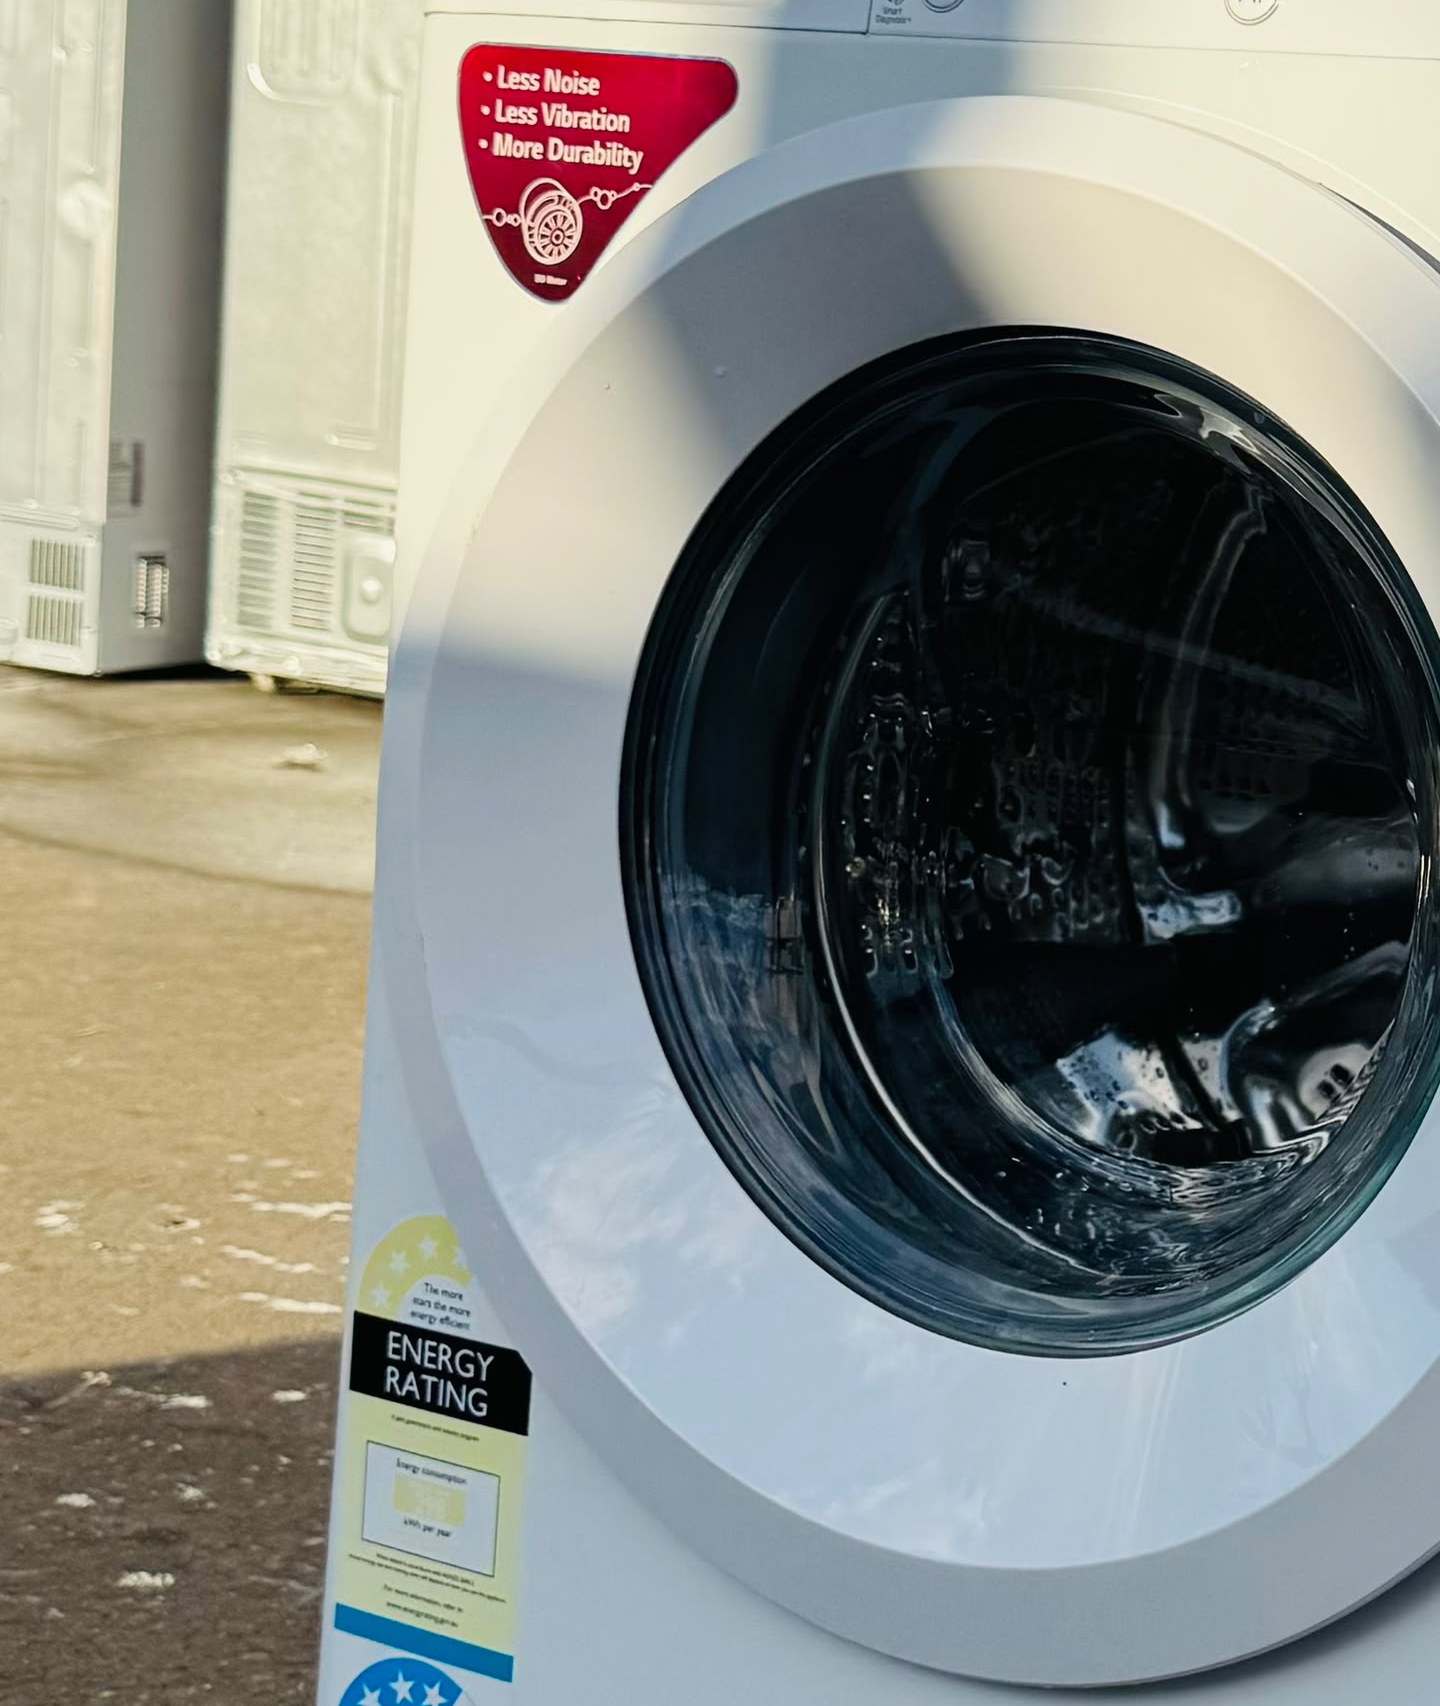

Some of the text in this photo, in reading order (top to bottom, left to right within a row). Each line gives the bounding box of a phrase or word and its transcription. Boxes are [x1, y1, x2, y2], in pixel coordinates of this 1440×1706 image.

[496, 64, 601, 97] Less Noise
[494, 98, 631, 133] Less Vibration
[492, 131, 644, 175] More Durability
[386, 1330, 495, 1384] ENERGY
[384, 1365, 489, 1418] RATING
